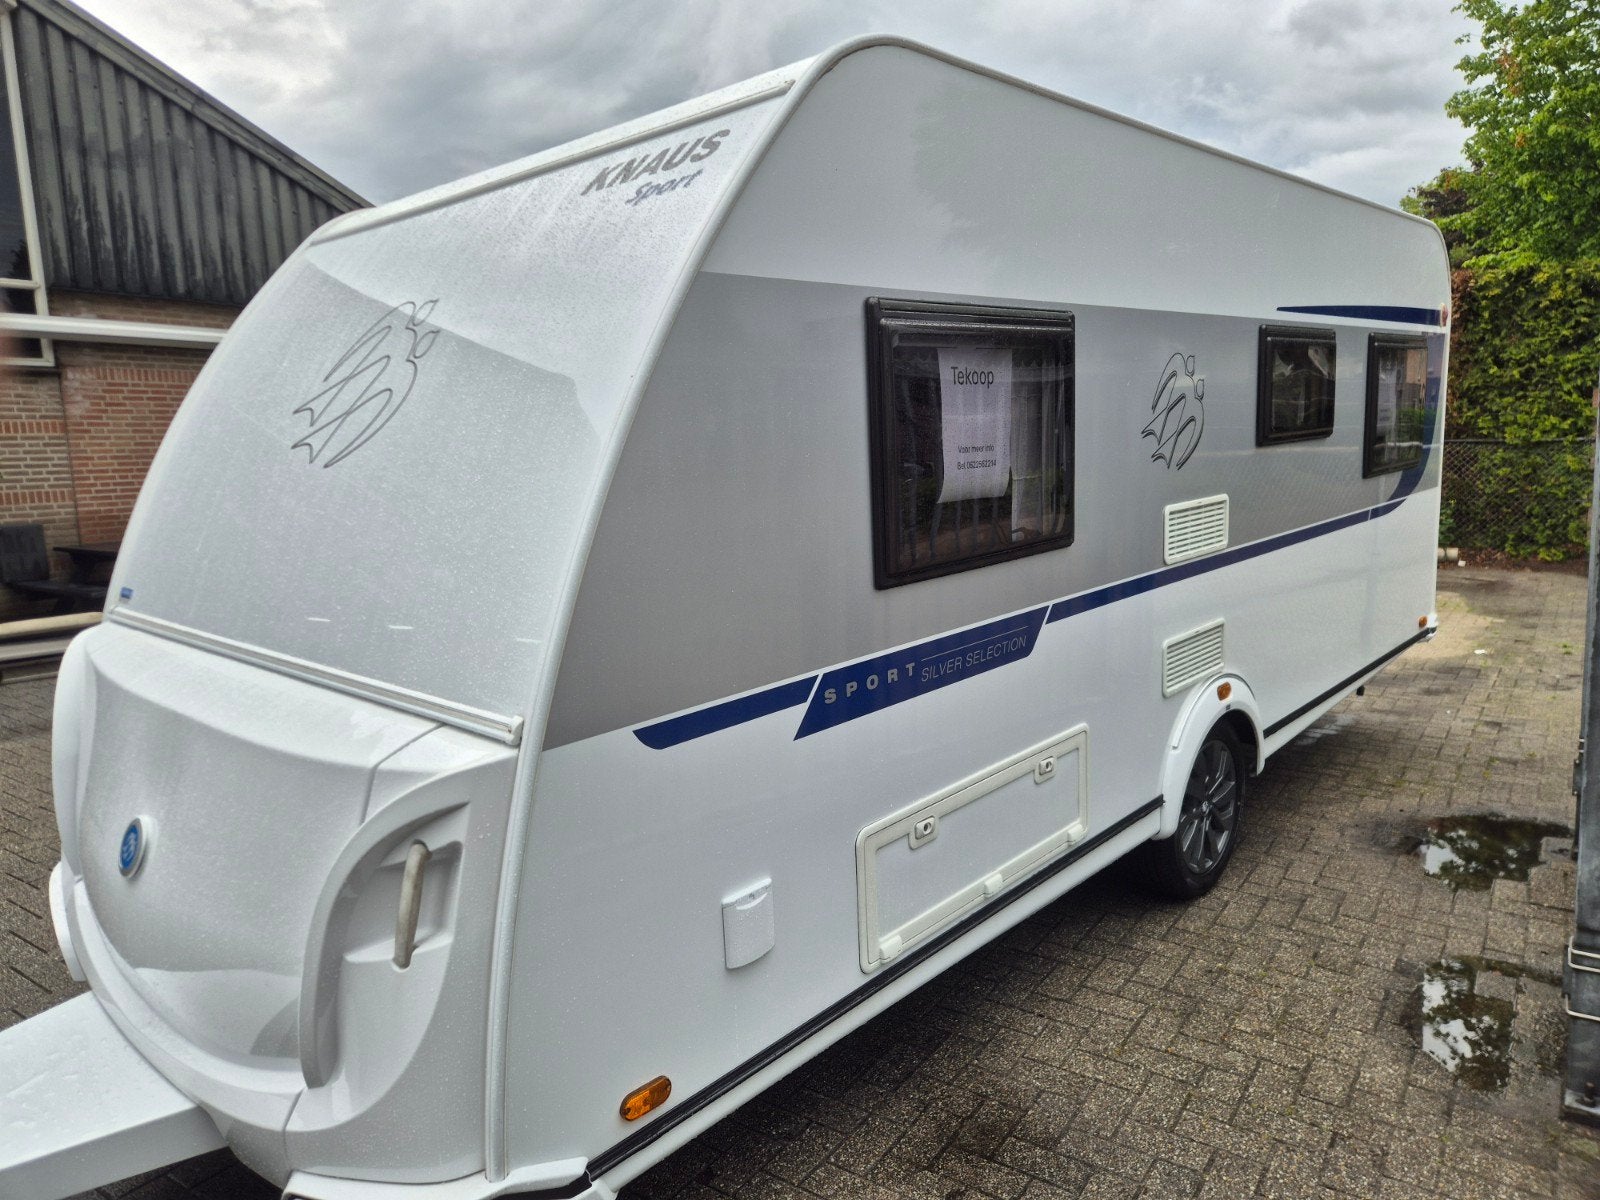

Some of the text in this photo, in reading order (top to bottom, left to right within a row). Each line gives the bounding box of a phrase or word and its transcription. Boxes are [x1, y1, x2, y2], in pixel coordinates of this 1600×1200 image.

[580, 128, 731, 196] KNAUS
[951, 366, 994, 389] Tekoop
[958, 444, 995, 453] Voor meer info
[824, 635, 1027, 704] SPORT SILVER SELECTION
